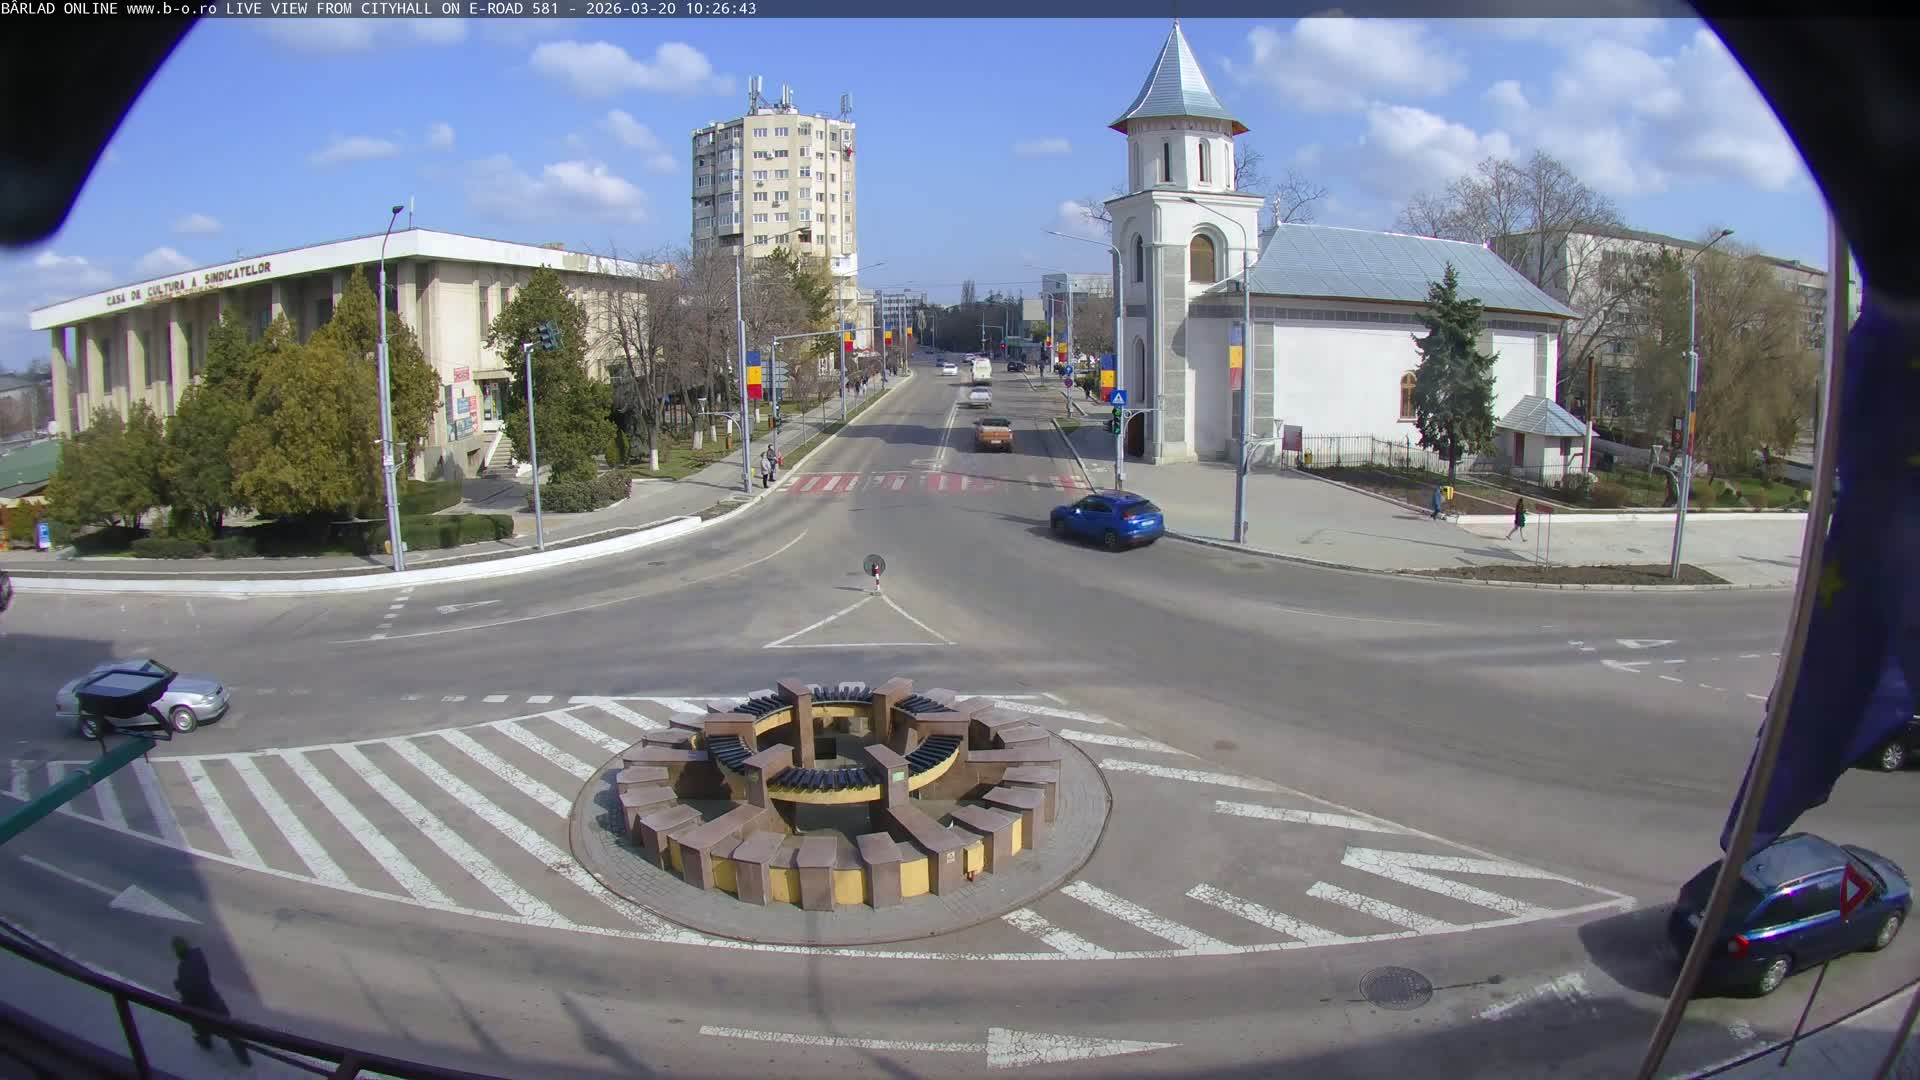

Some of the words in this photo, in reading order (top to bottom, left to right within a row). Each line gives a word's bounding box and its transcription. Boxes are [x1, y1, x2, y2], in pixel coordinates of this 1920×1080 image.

[106, 291, 126, 306] CASA
[148, 279, 185, 297] CULTURA
[204, 261, 271, 284] SINDICATELOR
